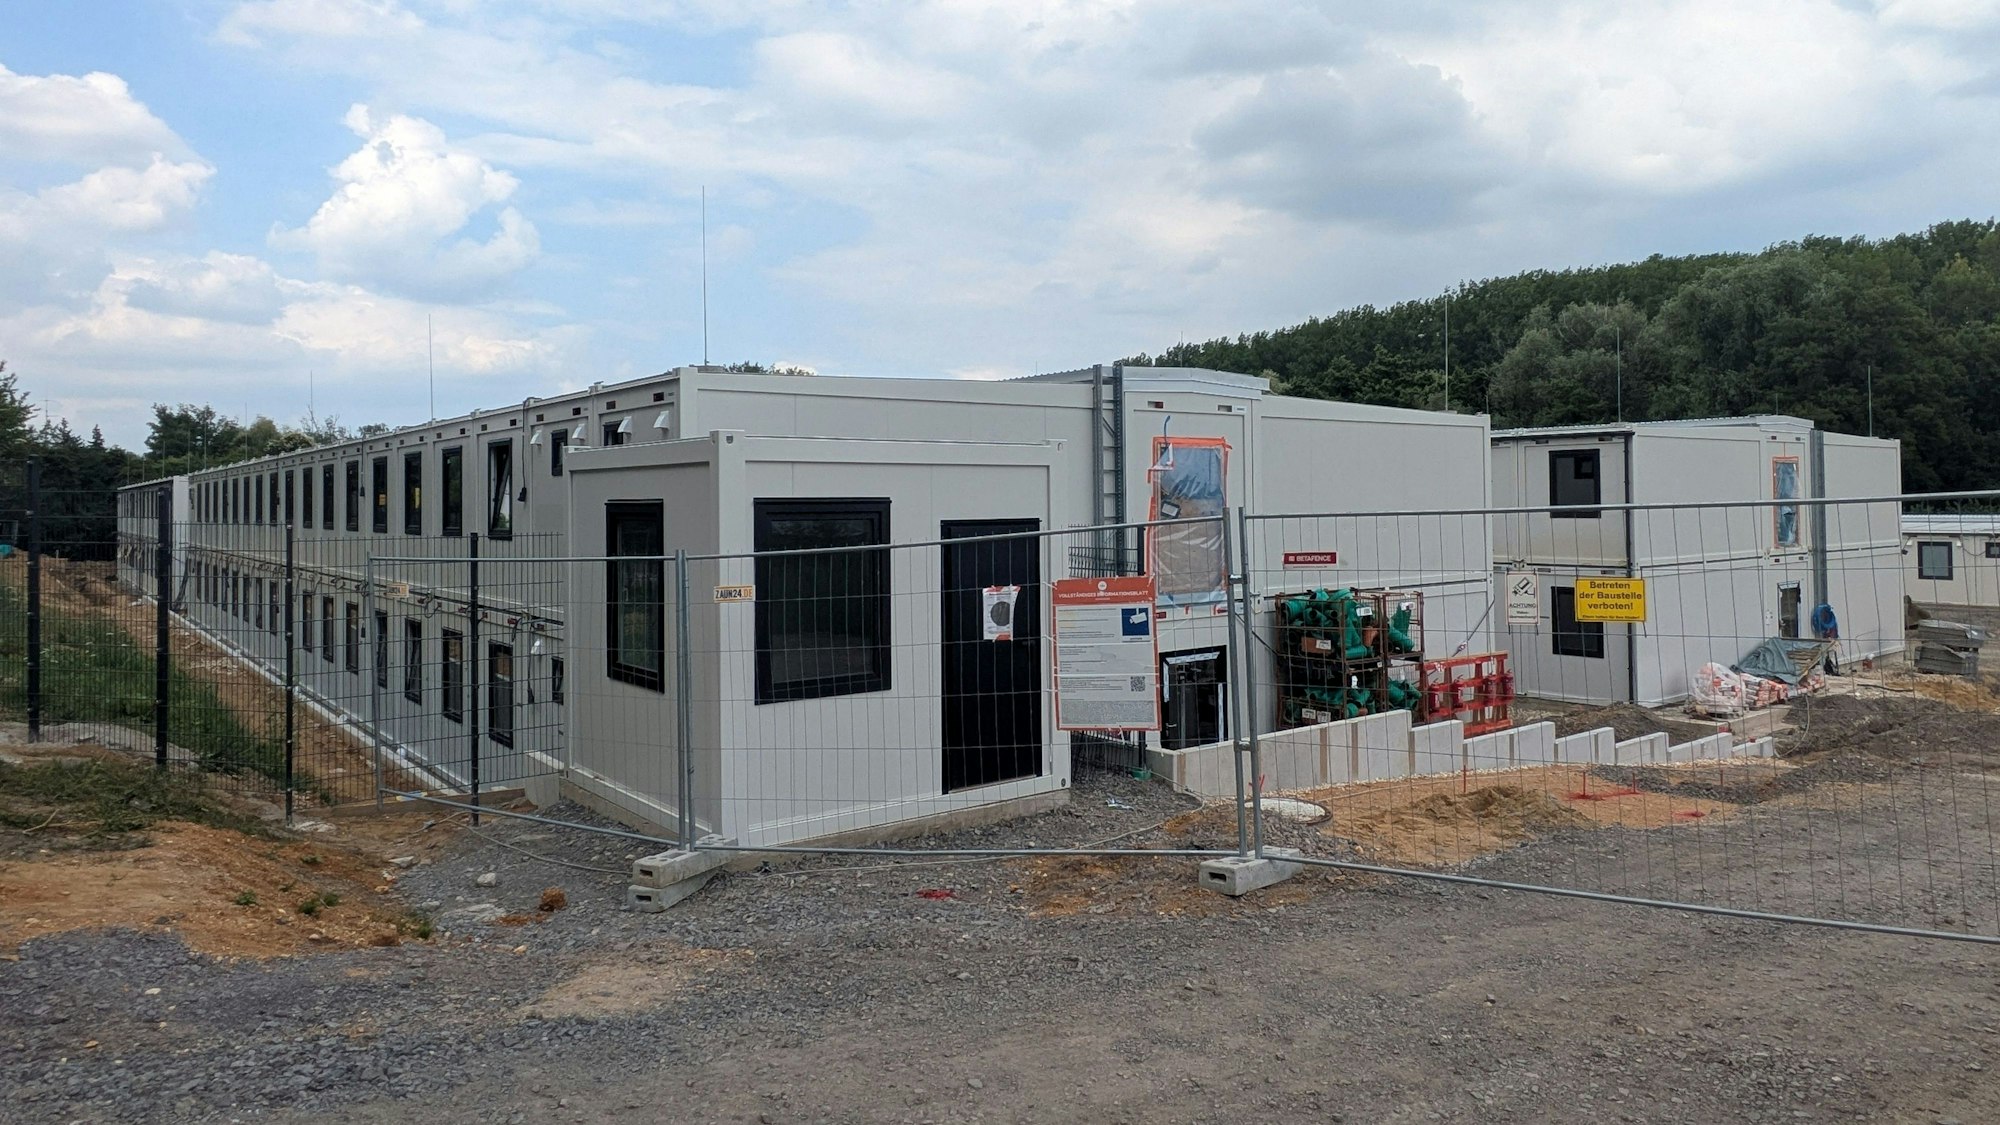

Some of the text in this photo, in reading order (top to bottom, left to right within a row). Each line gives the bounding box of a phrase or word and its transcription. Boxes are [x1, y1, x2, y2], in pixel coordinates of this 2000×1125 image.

[1590, 581, 1631, 589] Betreten
[715, 589, 753, 599] ZAUN24.DE
[1579, 591, 1642, 600] der Baustelle
[1587, 602, 1634, 610] verboten!
